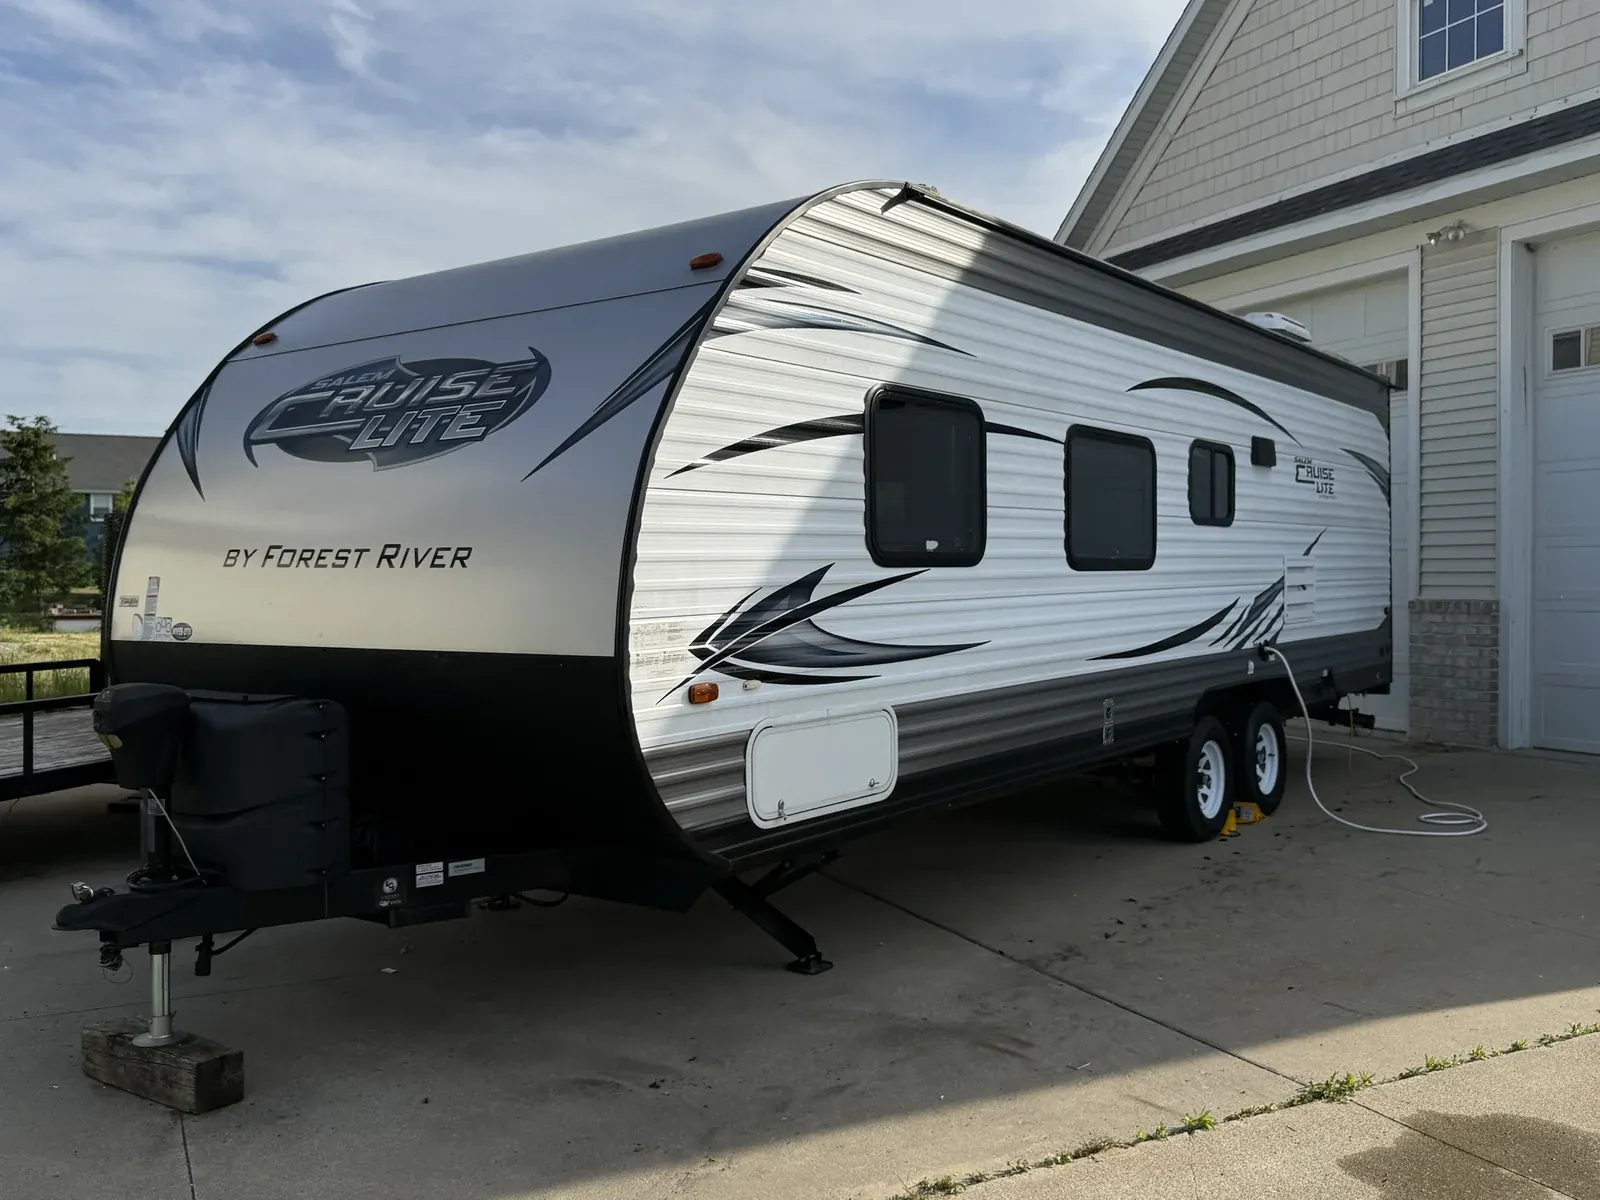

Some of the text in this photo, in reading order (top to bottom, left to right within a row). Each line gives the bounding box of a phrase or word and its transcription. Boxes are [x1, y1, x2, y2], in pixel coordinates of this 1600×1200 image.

[311, 369, 396, 391] SALEM
[249, 361, 538, 440] CRUISE
[349, 400, 506, 451] LITE
[1295, 464, 1335, 485] CRUISE
[1316, 481, 1335, 495] LITE
[223, 543, 473, 569] BY FOREST RIVER
